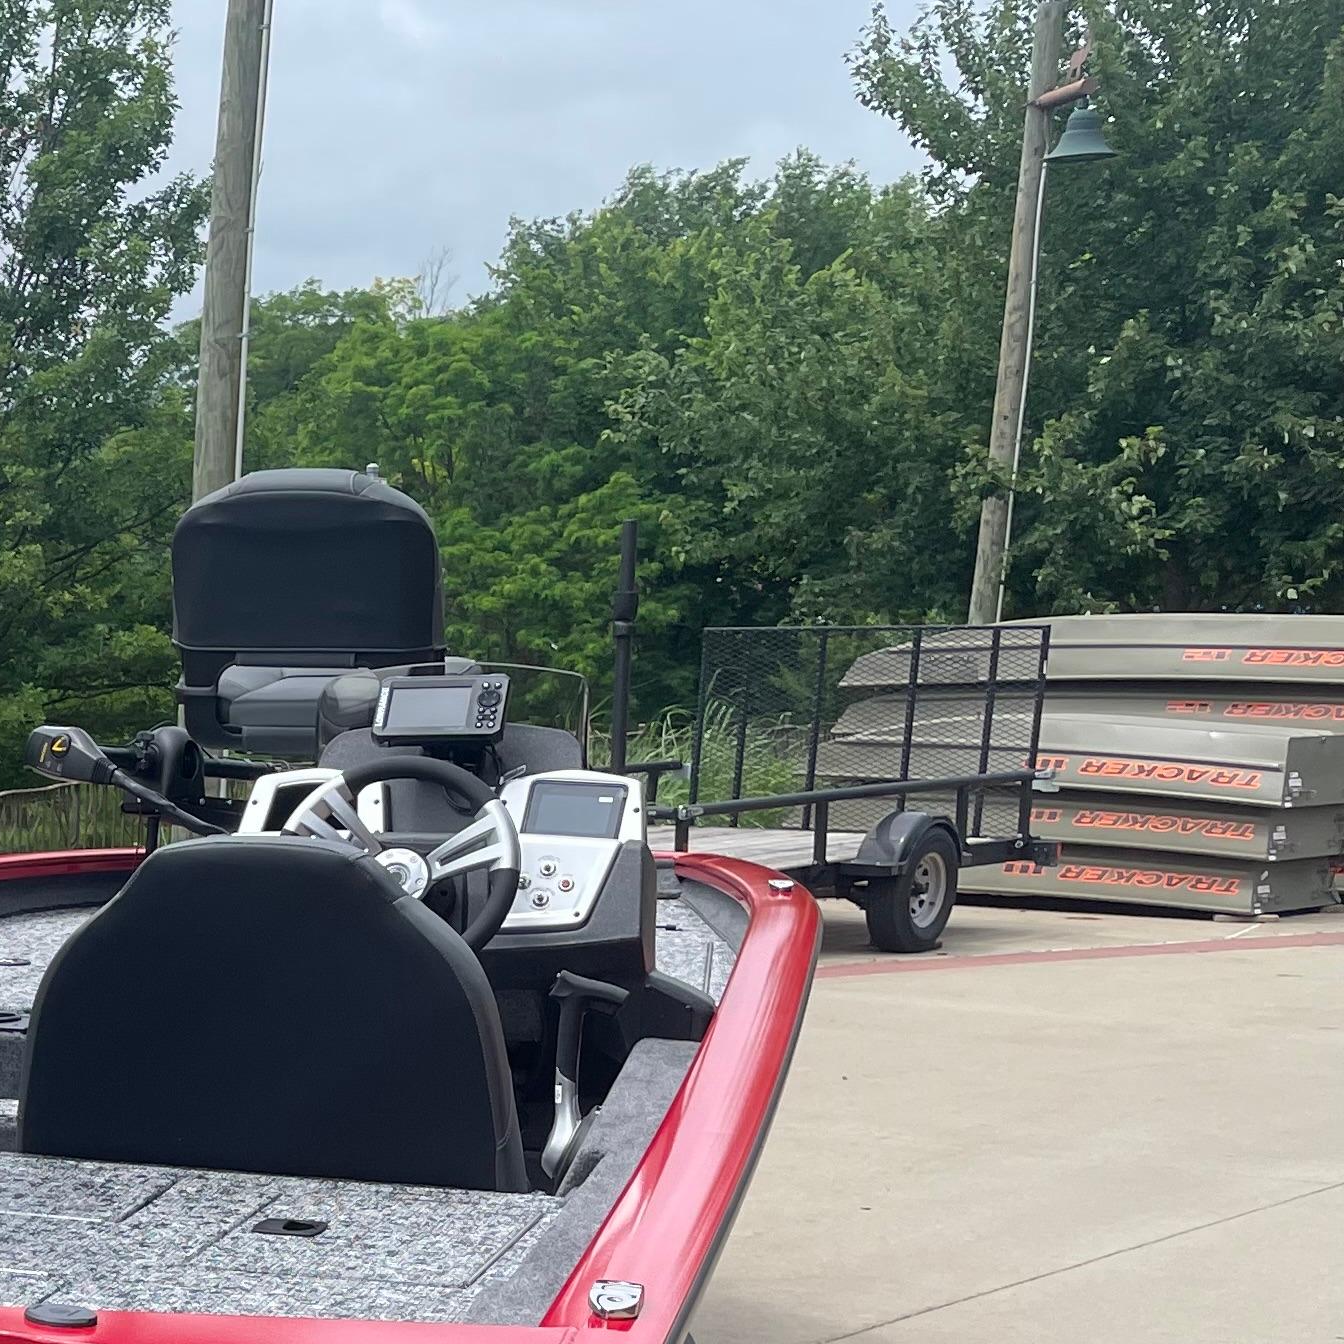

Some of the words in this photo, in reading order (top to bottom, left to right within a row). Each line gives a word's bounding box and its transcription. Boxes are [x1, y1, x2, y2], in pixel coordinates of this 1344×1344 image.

[1081, 759, 1262, 788] TRACKER
[1074, 810, 1255, 840] TRACKER
[1060, 865, 1240, 894] TRACKER
